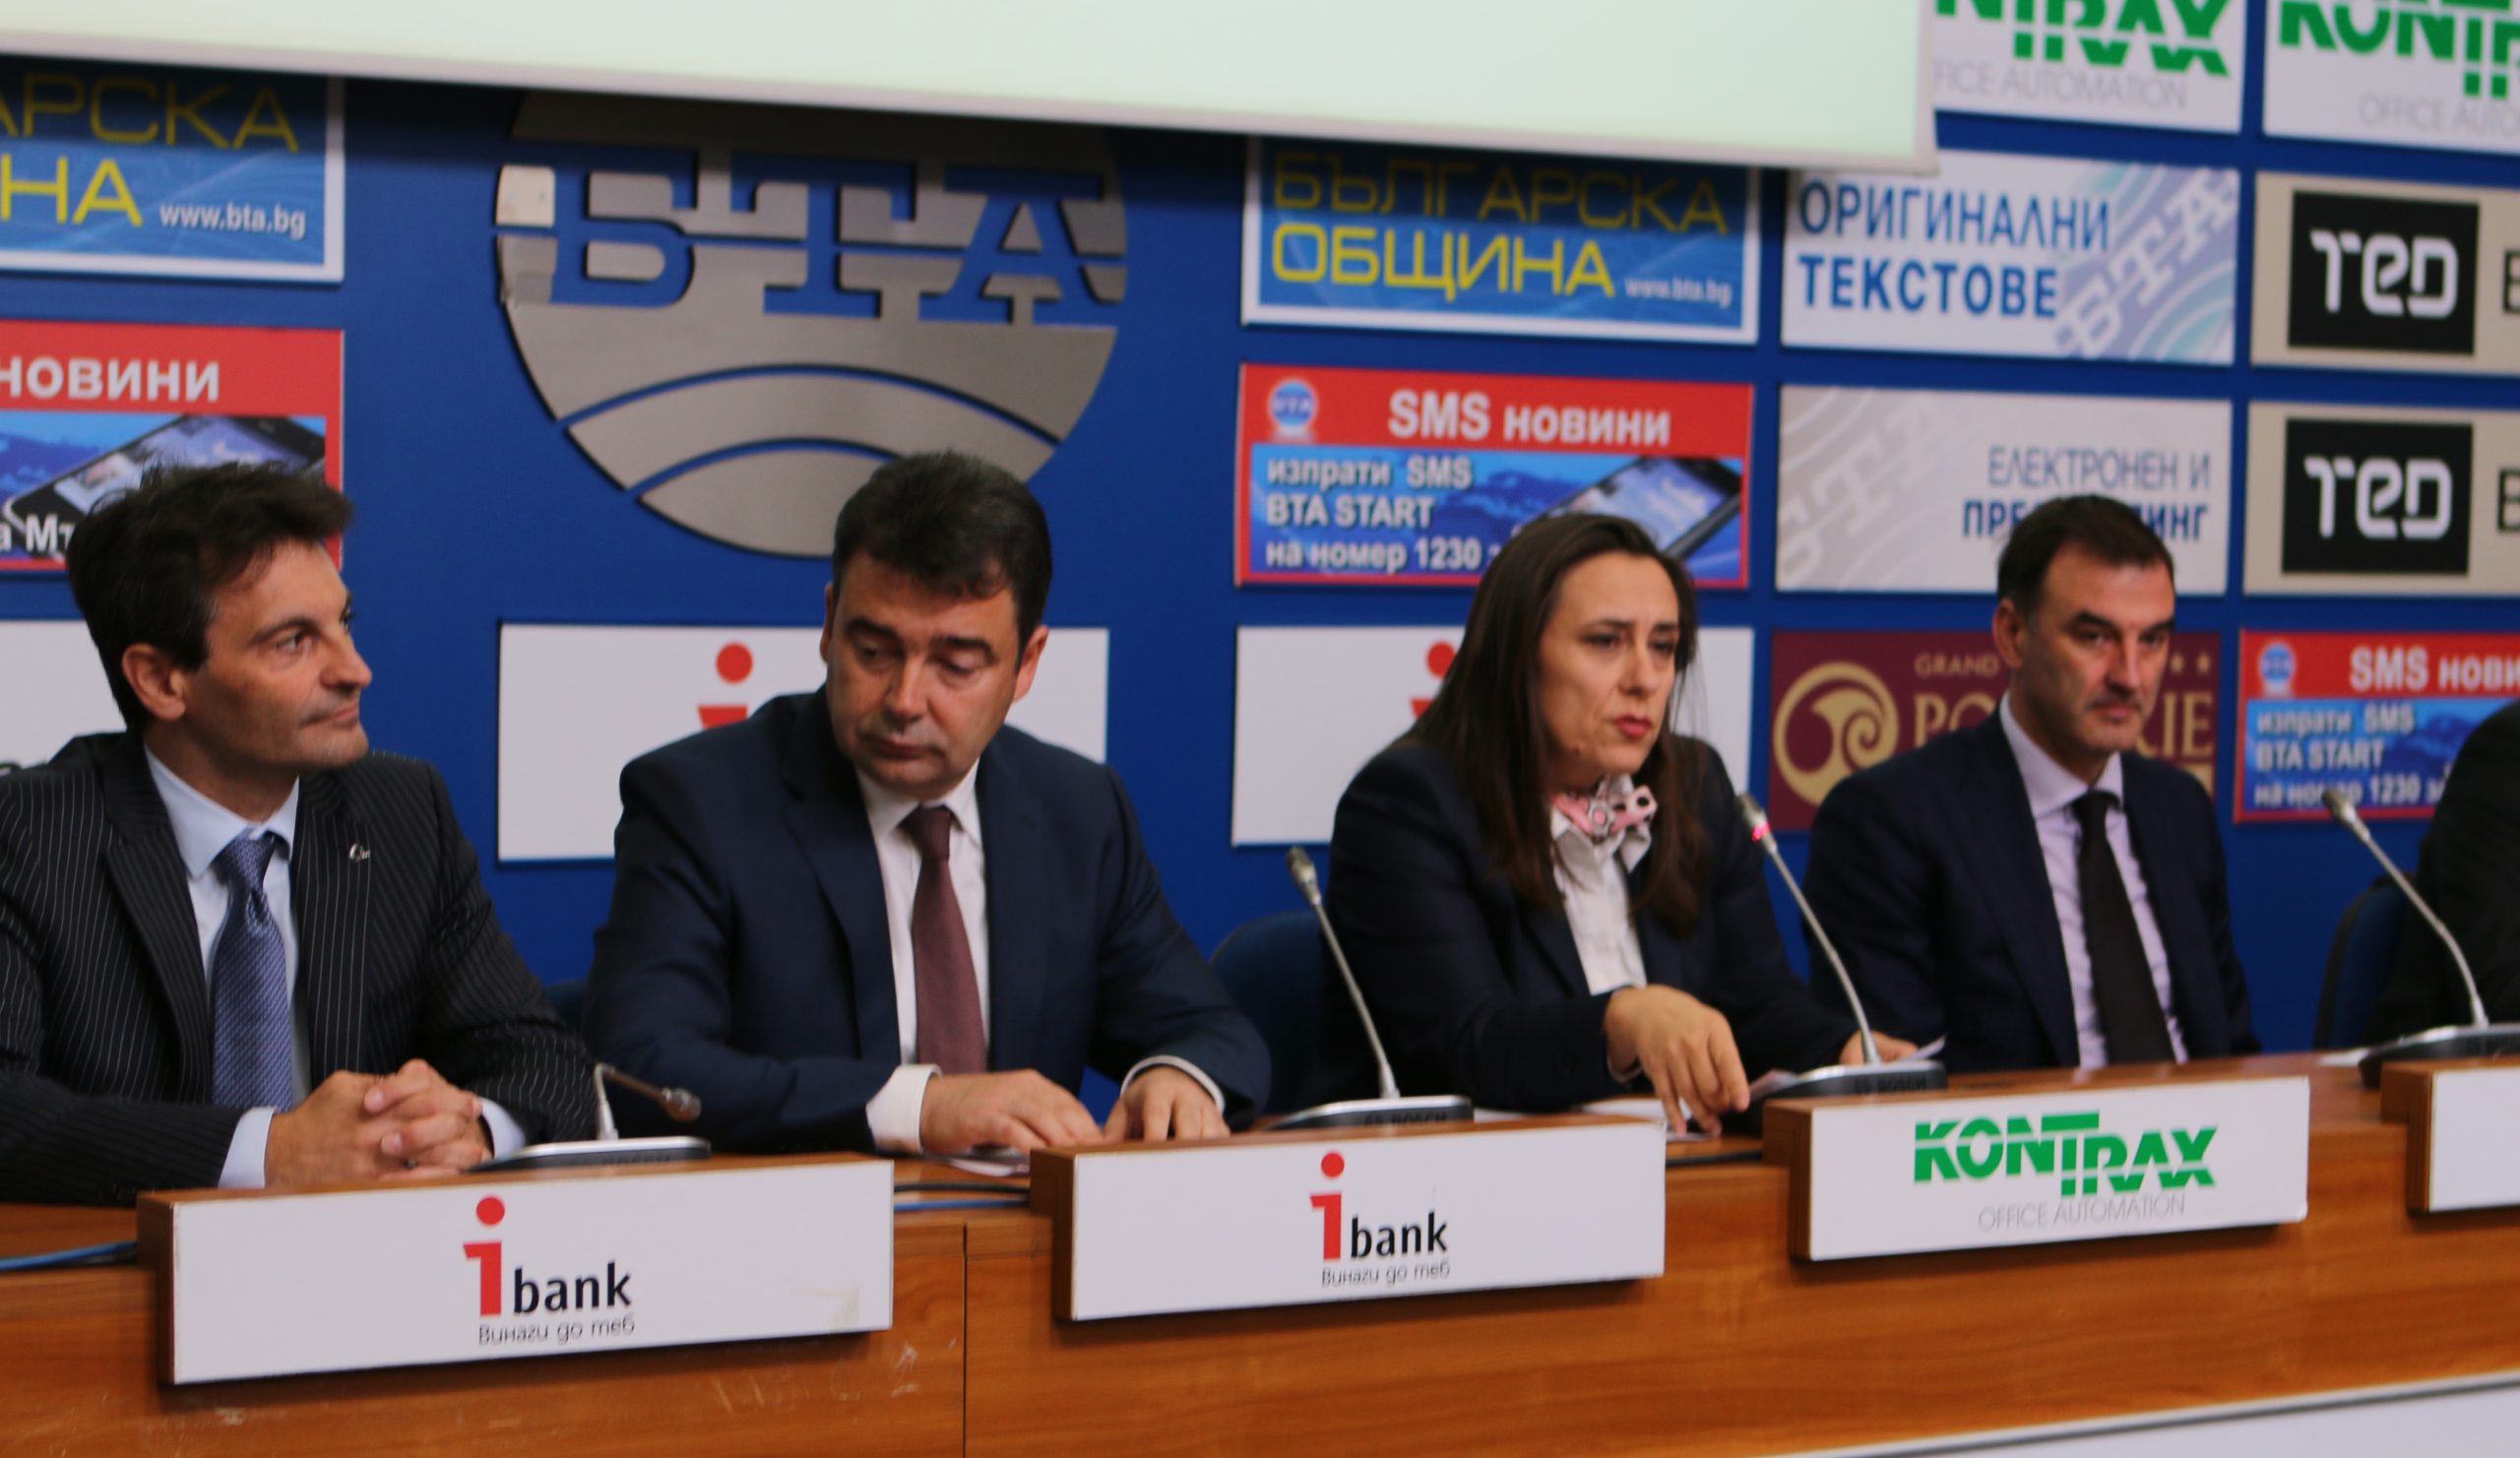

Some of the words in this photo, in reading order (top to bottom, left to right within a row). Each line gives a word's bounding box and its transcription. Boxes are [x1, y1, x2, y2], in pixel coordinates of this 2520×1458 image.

[1274, 153, 1729, 235] БЪЛГАРСКА
[159, 201, 307, 239] www.bta.bg
[1799, 181, 2110, 253] ОРИГИНАЛНИ
[549, 148, 1120, 328] БТА
[1273, 222, 1615, 303] ОБЩИНА
[1624, 275, 1733, 308] www.bta.bg
[1797, 253, 2057, 319] ТЕКСТОВЕ
[1388, 388, 1490, 440] SMS
[1267, 456, 1391, 491] изпрати
[1406, 455, 1474, 489] SMS
[1987, 445, 2178, 490] ЕЛЕКТРОНЕН
[2189, 451, 2211, 491] И
[1335, 495, 1436, 529] START
[1266, 539, 1304, 567] на
[1309, 539, 1408, 574] номер
[1414, 537, 1482, 569] 1230
[1915, 653, 1999, 677] GRAND
[2350, 646, 2429, 693] SMS
[2364, 702, 2416, 735] SMS
[1914, 1109, 2218, 1198] KONTRAX
[1978, 1199, 2048, 1231] OFFICE
[2052, 1193, 2185, 1227] AUTOMATION
[1321, 1267, 1379, 1288] Винаги
[1415, 1259, 1451, 1280] теб
[478, 1322, 549, 1347] Винаги
[591, 1311, 636, 1339] теб
